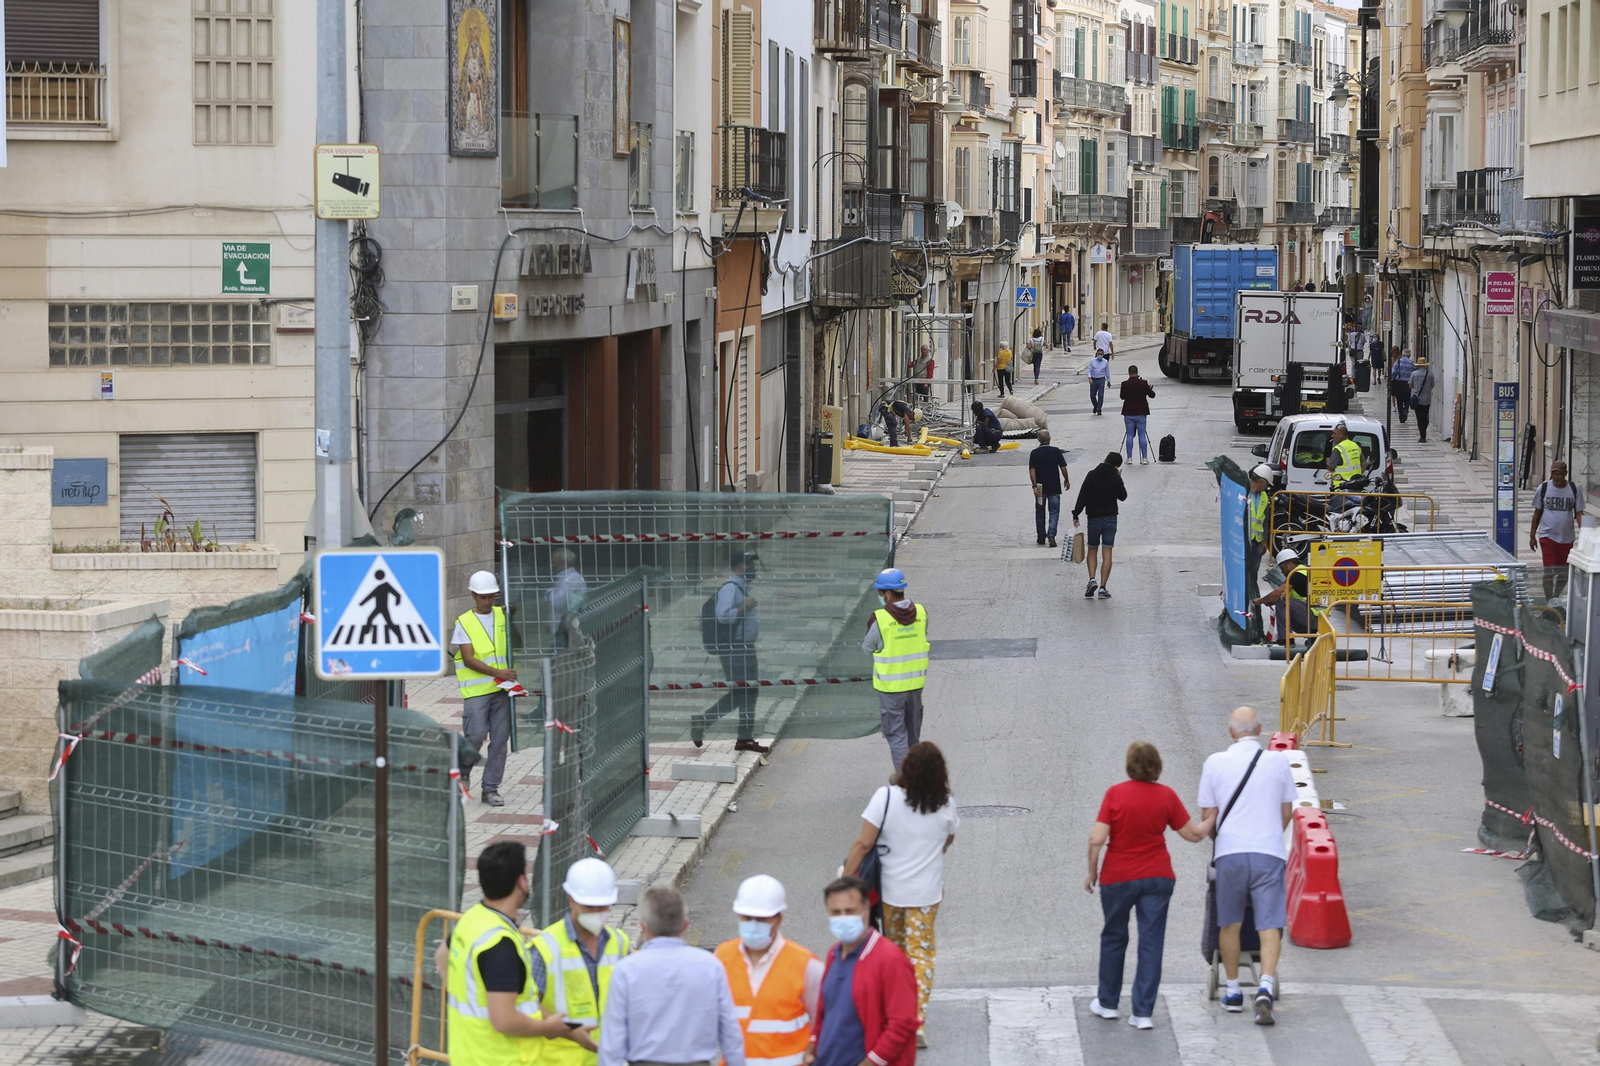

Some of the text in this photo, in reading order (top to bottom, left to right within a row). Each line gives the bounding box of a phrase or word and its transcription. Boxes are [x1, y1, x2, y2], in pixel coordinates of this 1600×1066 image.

[224, 252, 270, 260] EVACUACION
[1488, 304, 1513, 312] COMUNIONES
[1244, 310, 1301, 325] RDA
[1499, 386, 1515, 397] BUS
[1502, 411, 1512, 419] 36
[1546, 496, 1575, 510] BERLIN
